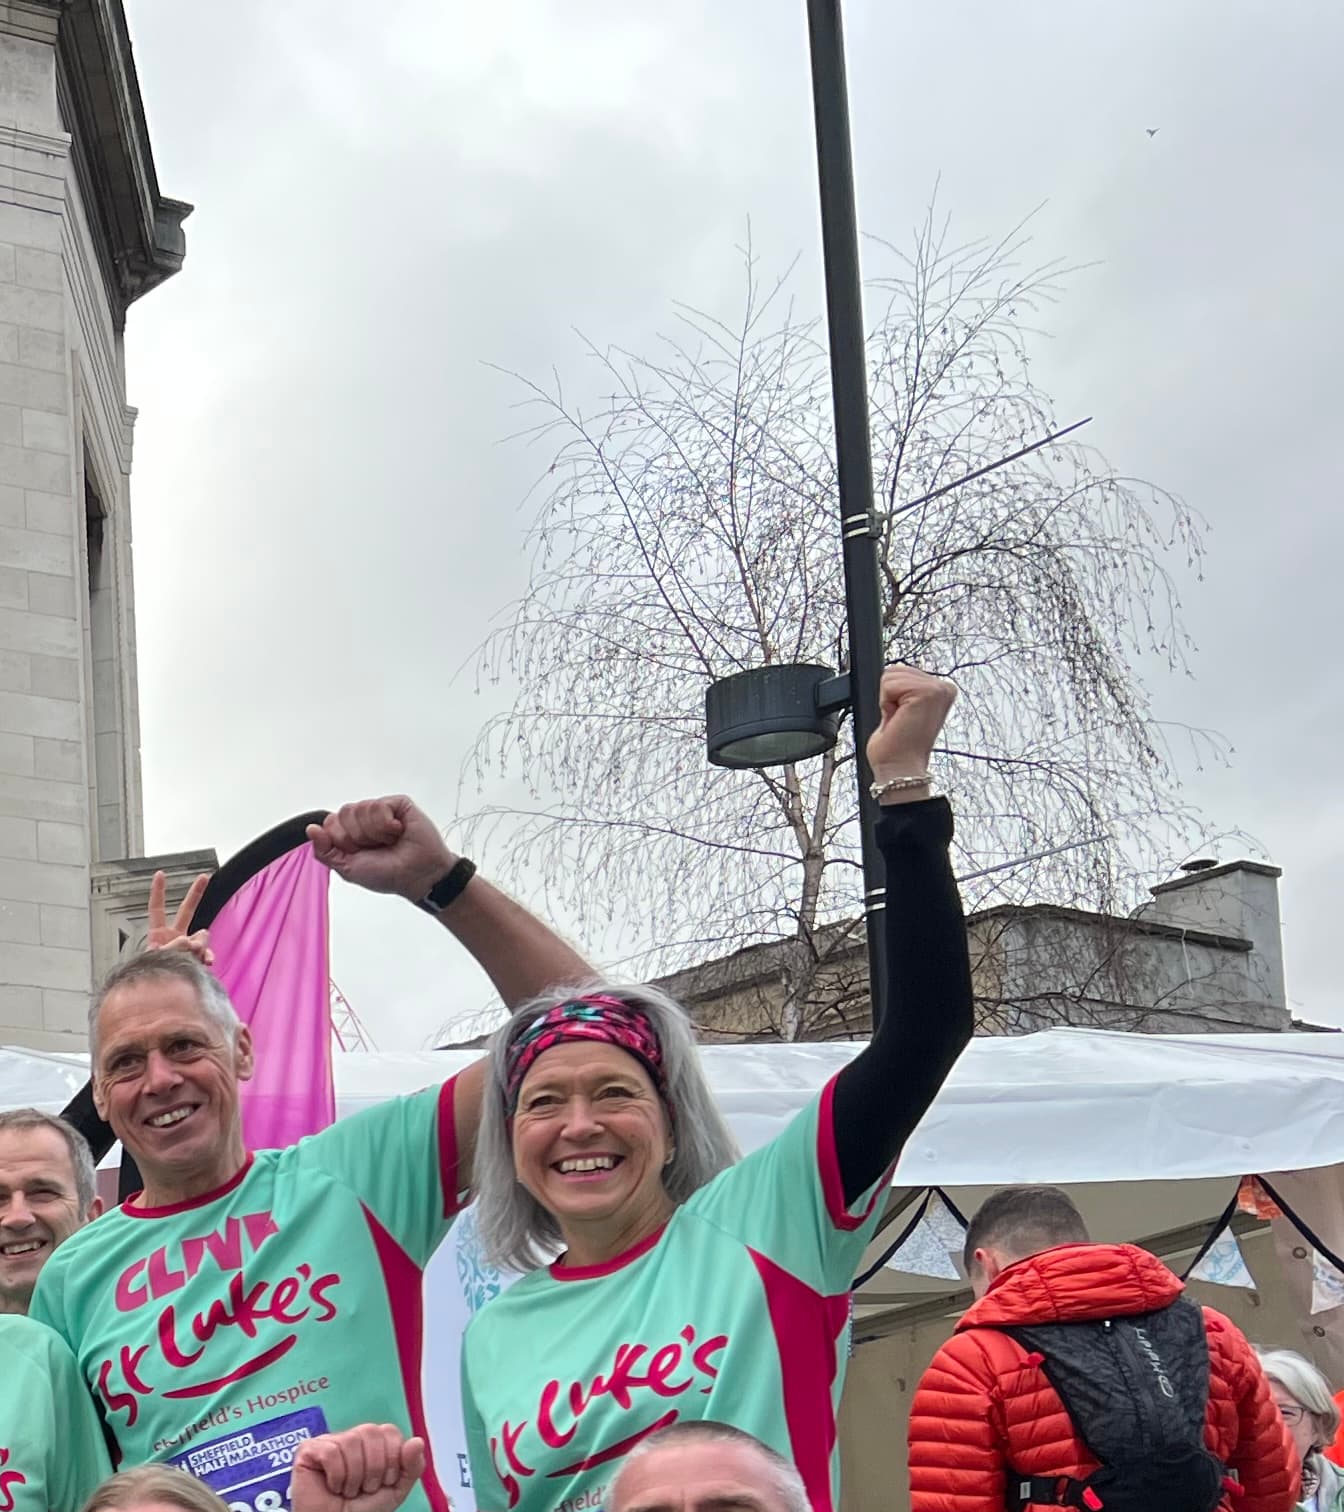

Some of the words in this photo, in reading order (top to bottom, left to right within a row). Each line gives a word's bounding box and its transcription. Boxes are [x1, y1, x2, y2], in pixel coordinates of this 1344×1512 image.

[158, 1263, 340, 1368] Luke's
[247, 1375, 330, 1414] Hospice
[191, 1436, 252, 1466] SHEFFIELD
[194, 1456, 227, 1478] HALF
[229, 1430, 309, 1466] MARATHON
[268, 1449, 297, 1469] 20
